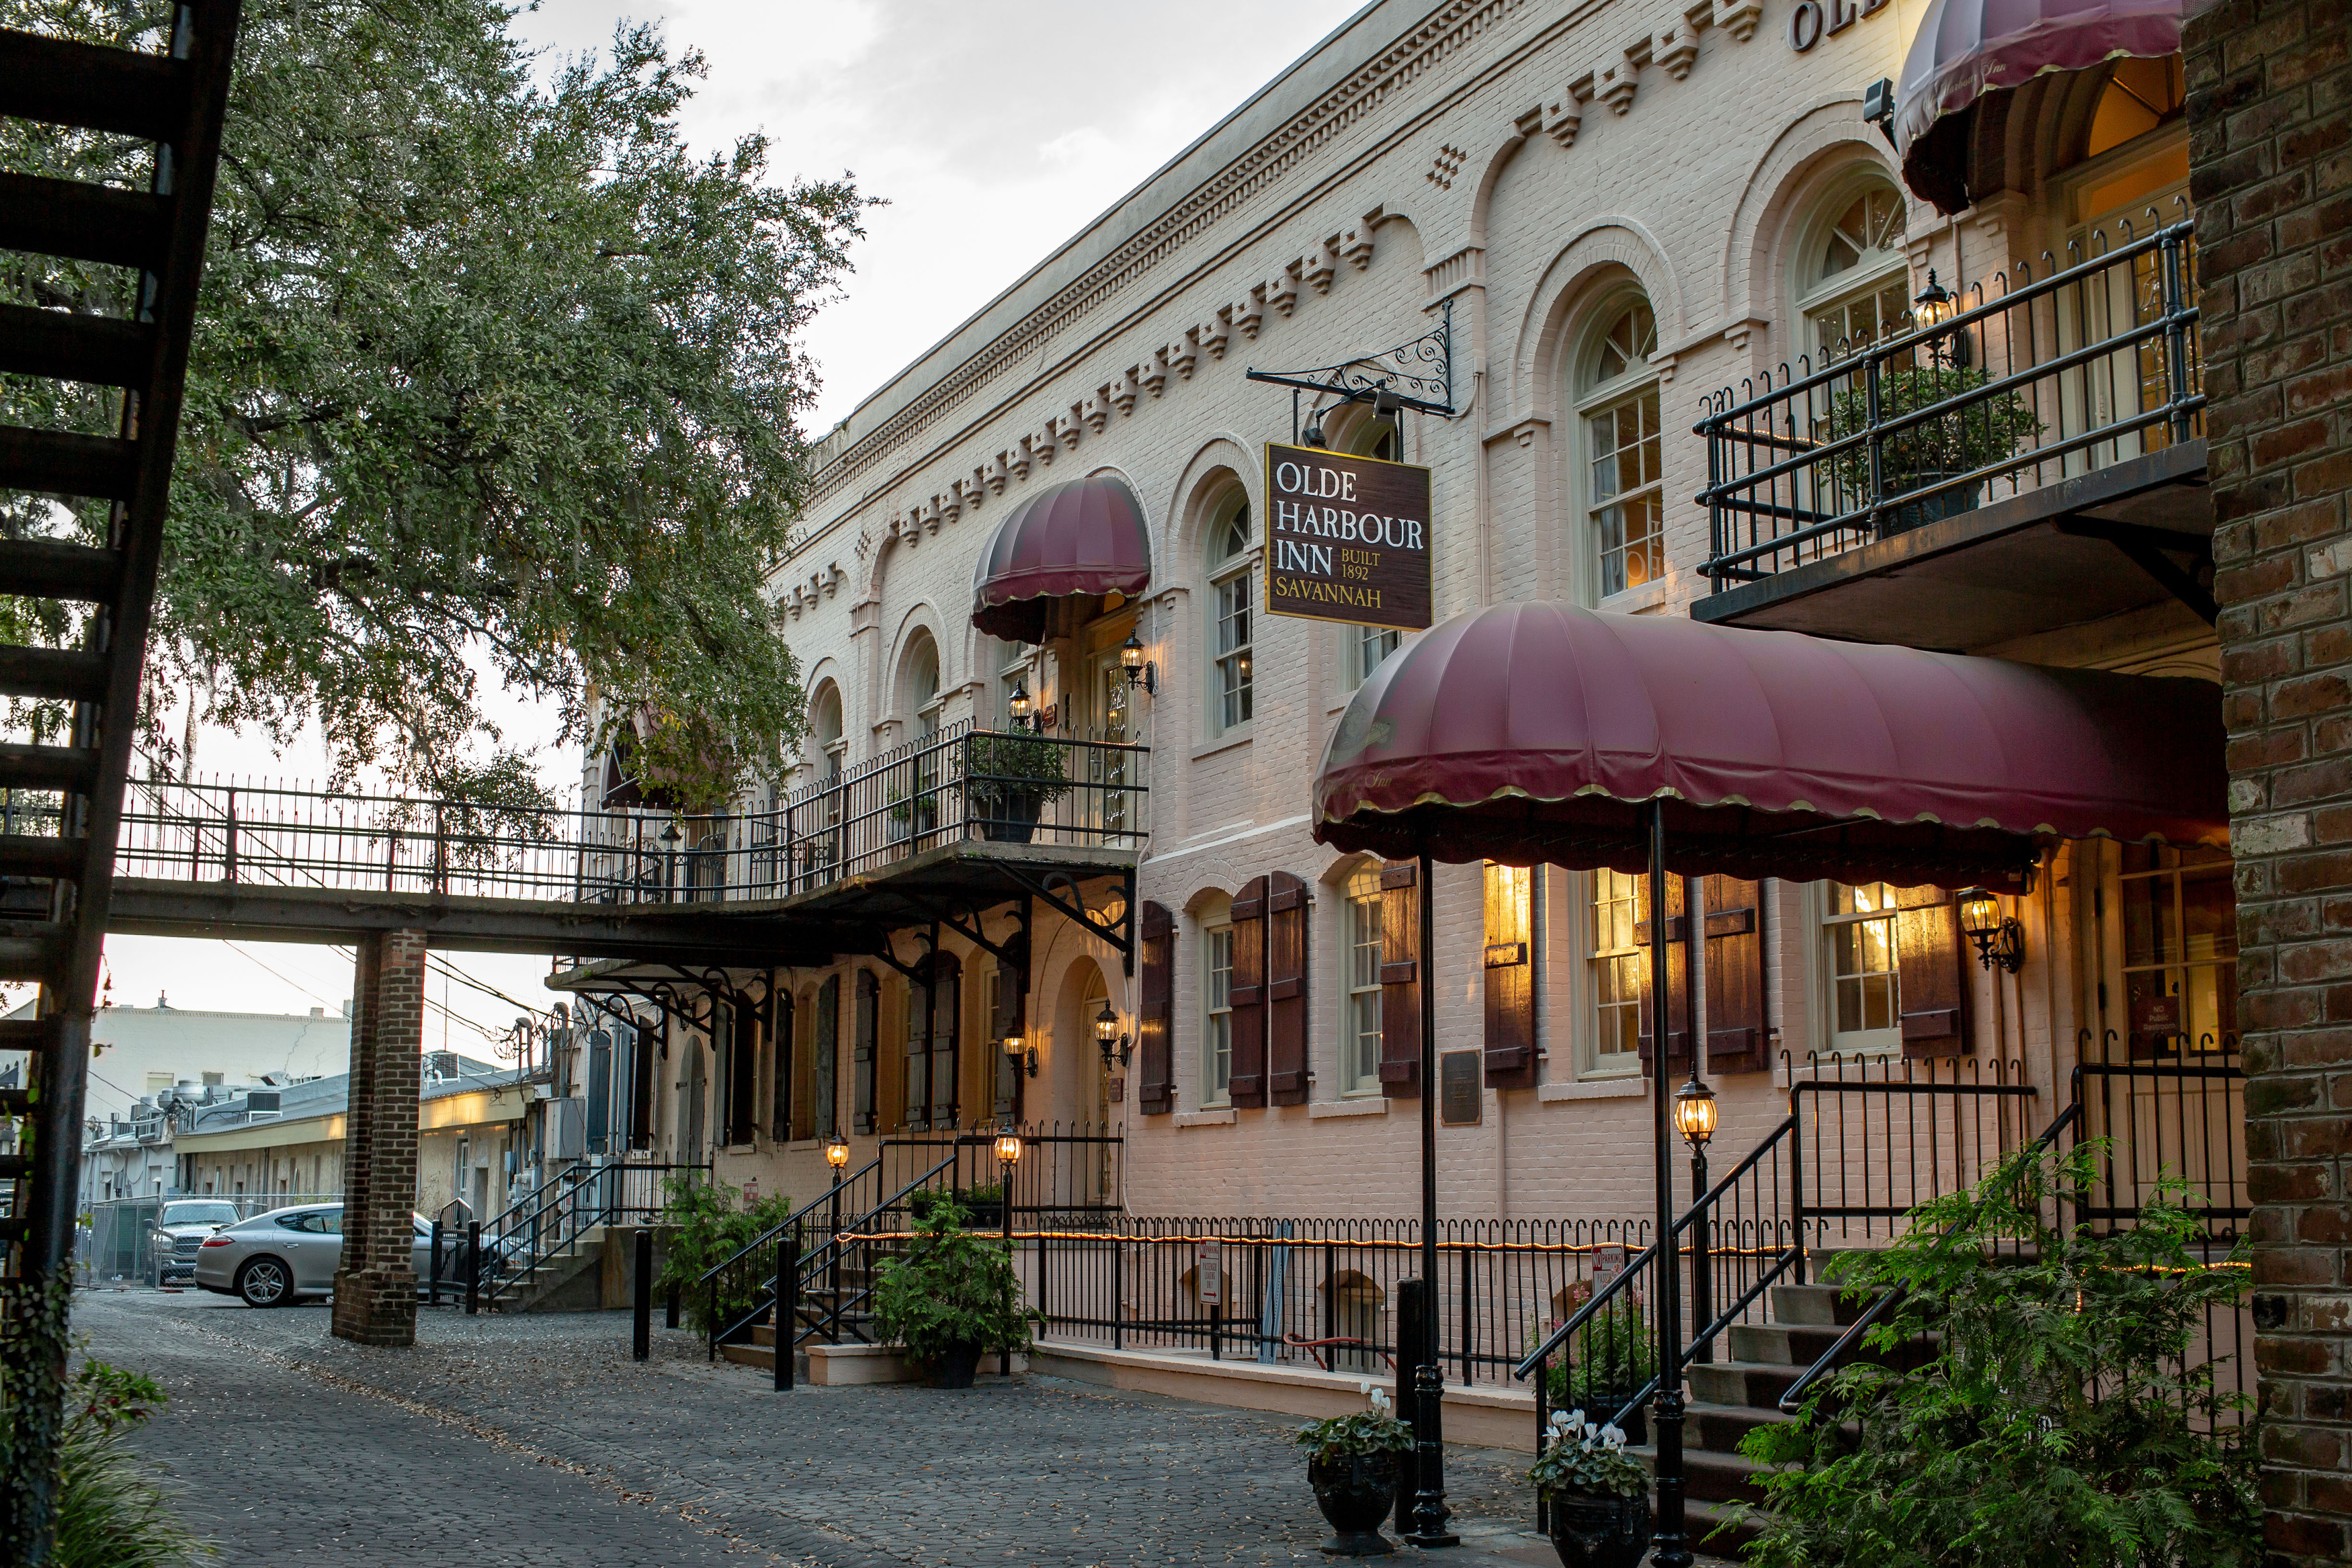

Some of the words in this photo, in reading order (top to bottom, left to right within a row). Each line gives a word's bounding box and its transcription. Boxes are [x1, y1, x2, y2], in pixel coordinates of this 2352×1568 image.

[1982, 58, 2007, 77] Inn
[1277, 462, 1357, 502] OLDE
[1277, 500, 1423, 550] HARBOUR
[1277, 539, 1333, 576] INN
[1341, 548, 1381, 566] BUILT
[1342, 564, 1369, 580] 1892
[1276, 576, 1382, 609] SAVANNAH
[1365, 770, 1392, 788] Inn
[1593, 1252, 1602, 1268] NO
[1602, 1253, 1622, 1264] PARKING
